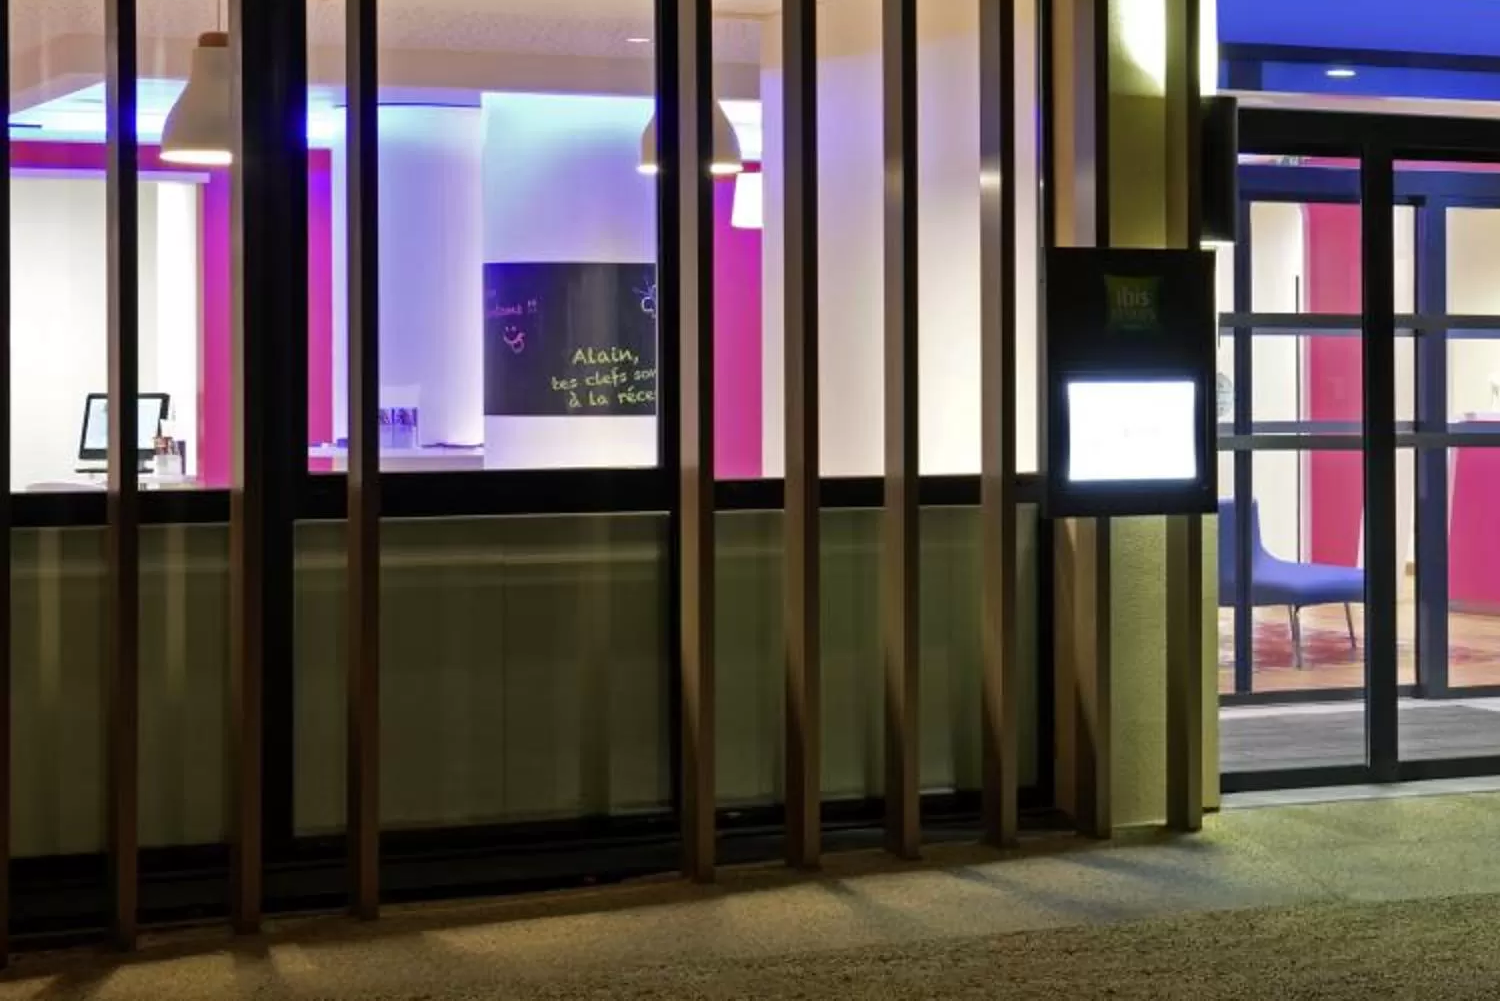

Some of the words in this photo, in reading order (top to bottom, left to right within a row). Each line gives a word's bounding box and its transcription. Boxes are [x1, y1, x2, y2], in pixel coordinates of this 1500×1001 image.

[585, 366, 627, 387] clefs
[589, 390, 609, 406] la
[617, 385, 656, 404] réce
